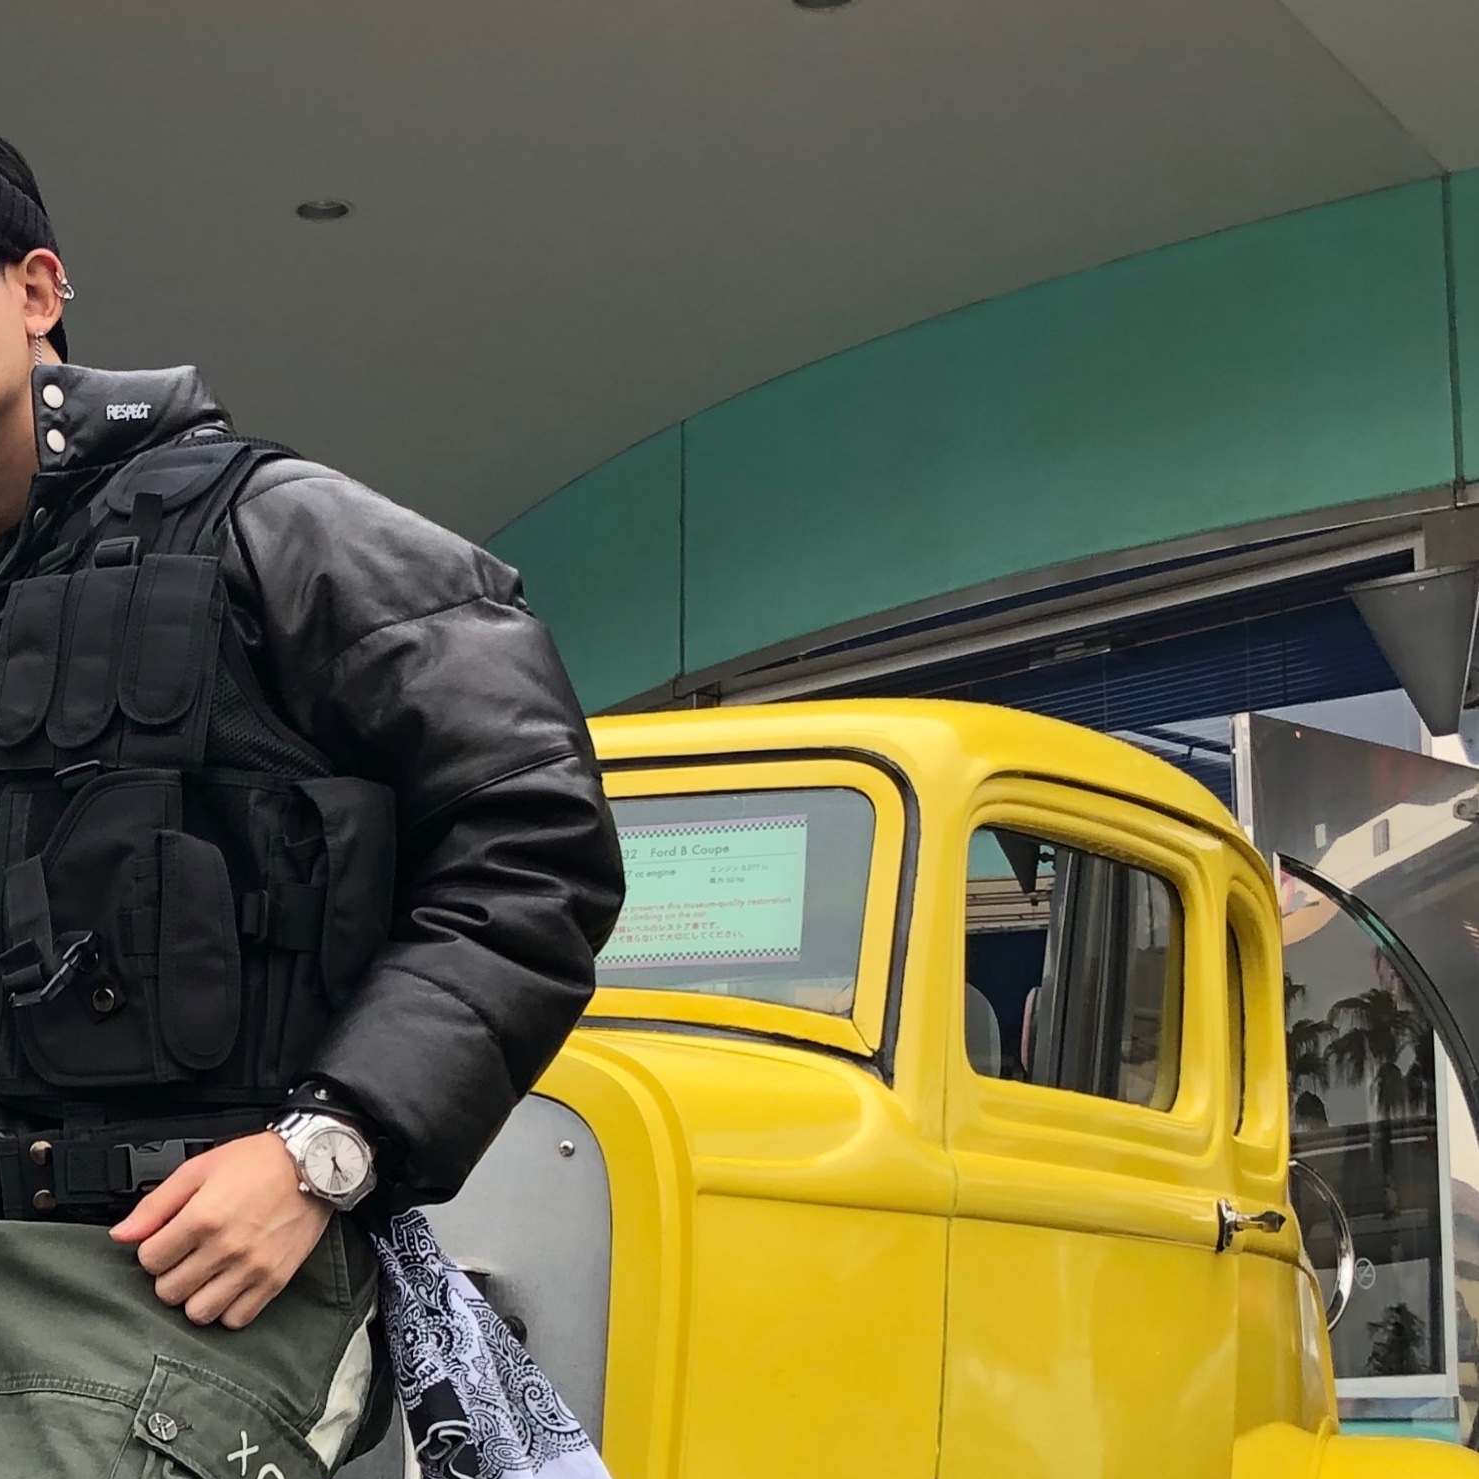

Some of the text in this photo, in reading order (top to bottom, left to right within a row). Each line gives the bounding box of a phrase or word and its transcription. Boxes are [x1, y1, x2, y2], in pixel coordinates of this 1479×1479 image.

[106, 401, 152, 421] RESPECT
[650, 845, 677, 858] Ford
[680, 845, 688, 856] B
[691, 844, 730, 857] Coupe
[646, 869, 676, 879] engine
